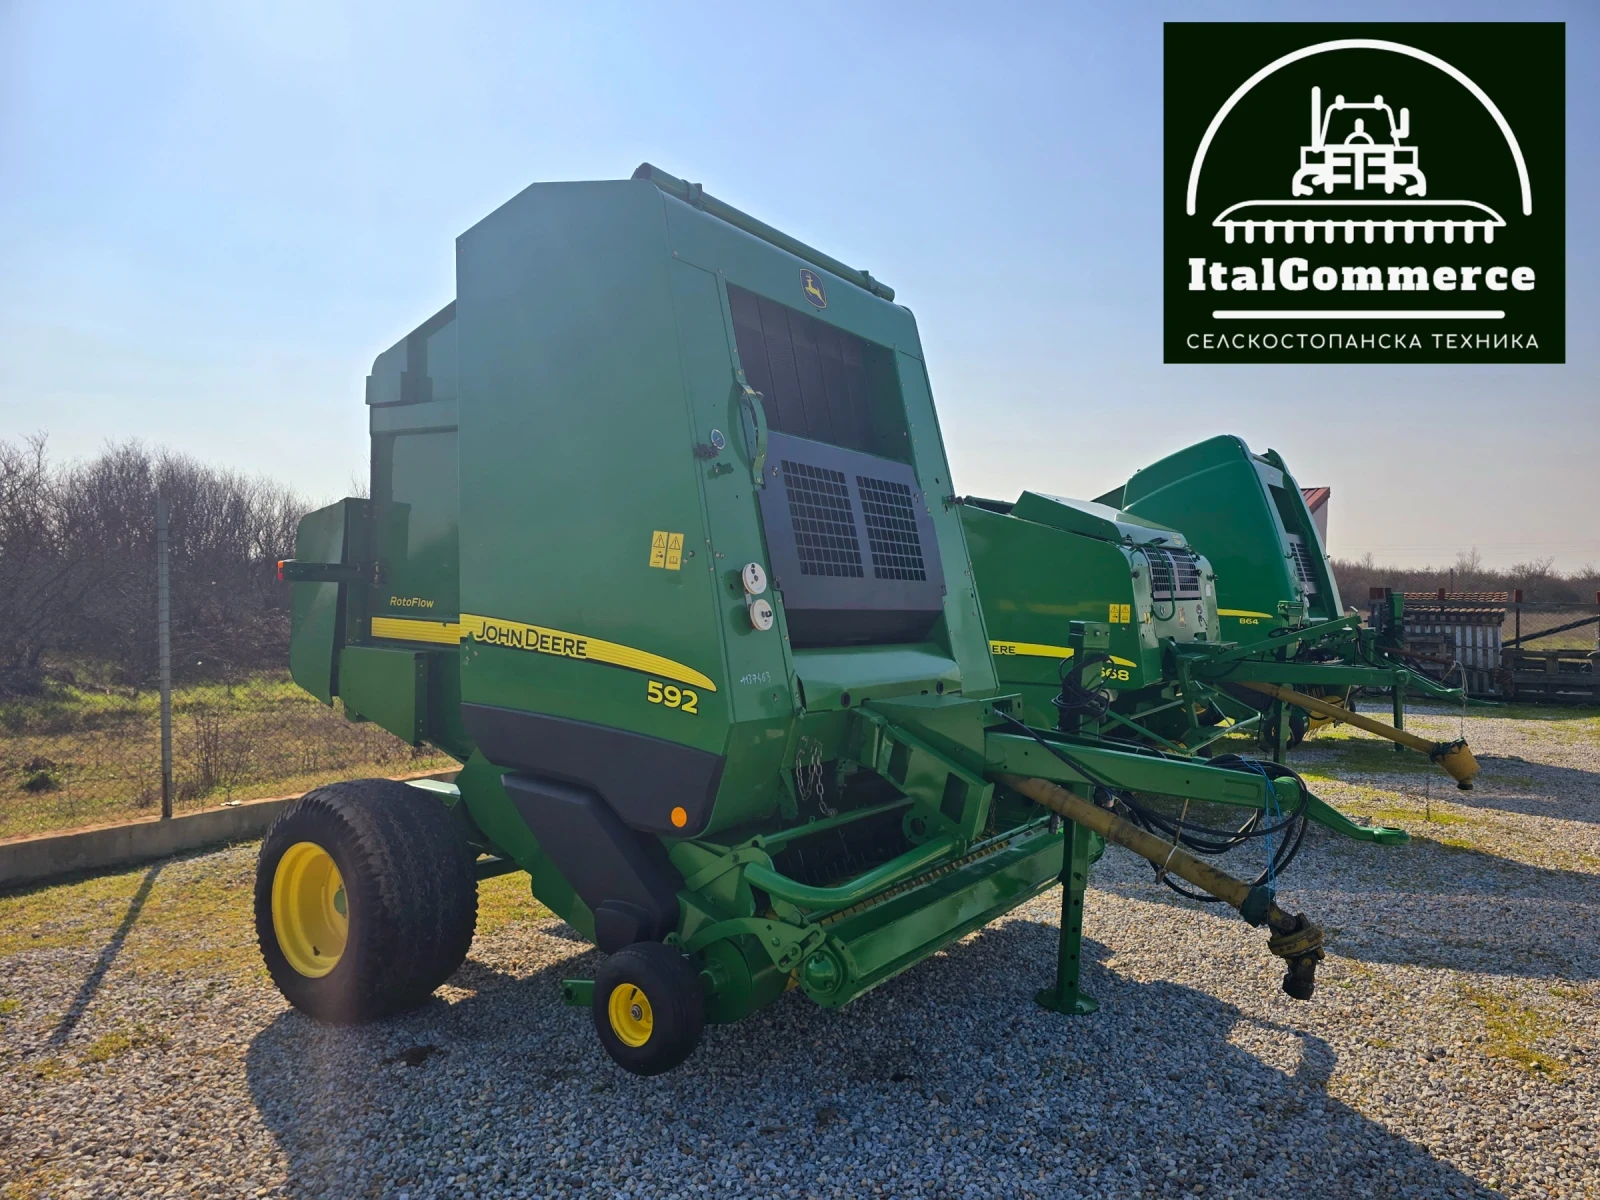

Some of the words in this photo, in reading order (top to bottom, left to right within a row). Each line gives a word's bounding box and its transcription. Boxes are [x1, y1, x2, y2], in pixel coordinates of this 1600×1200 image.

[390, 596, 434, 609] RotoFlow
[476, 621, 525, 648] JOHN
[525, 628, 588, 657] DEERE
[647, 679, 699, 715] 592
